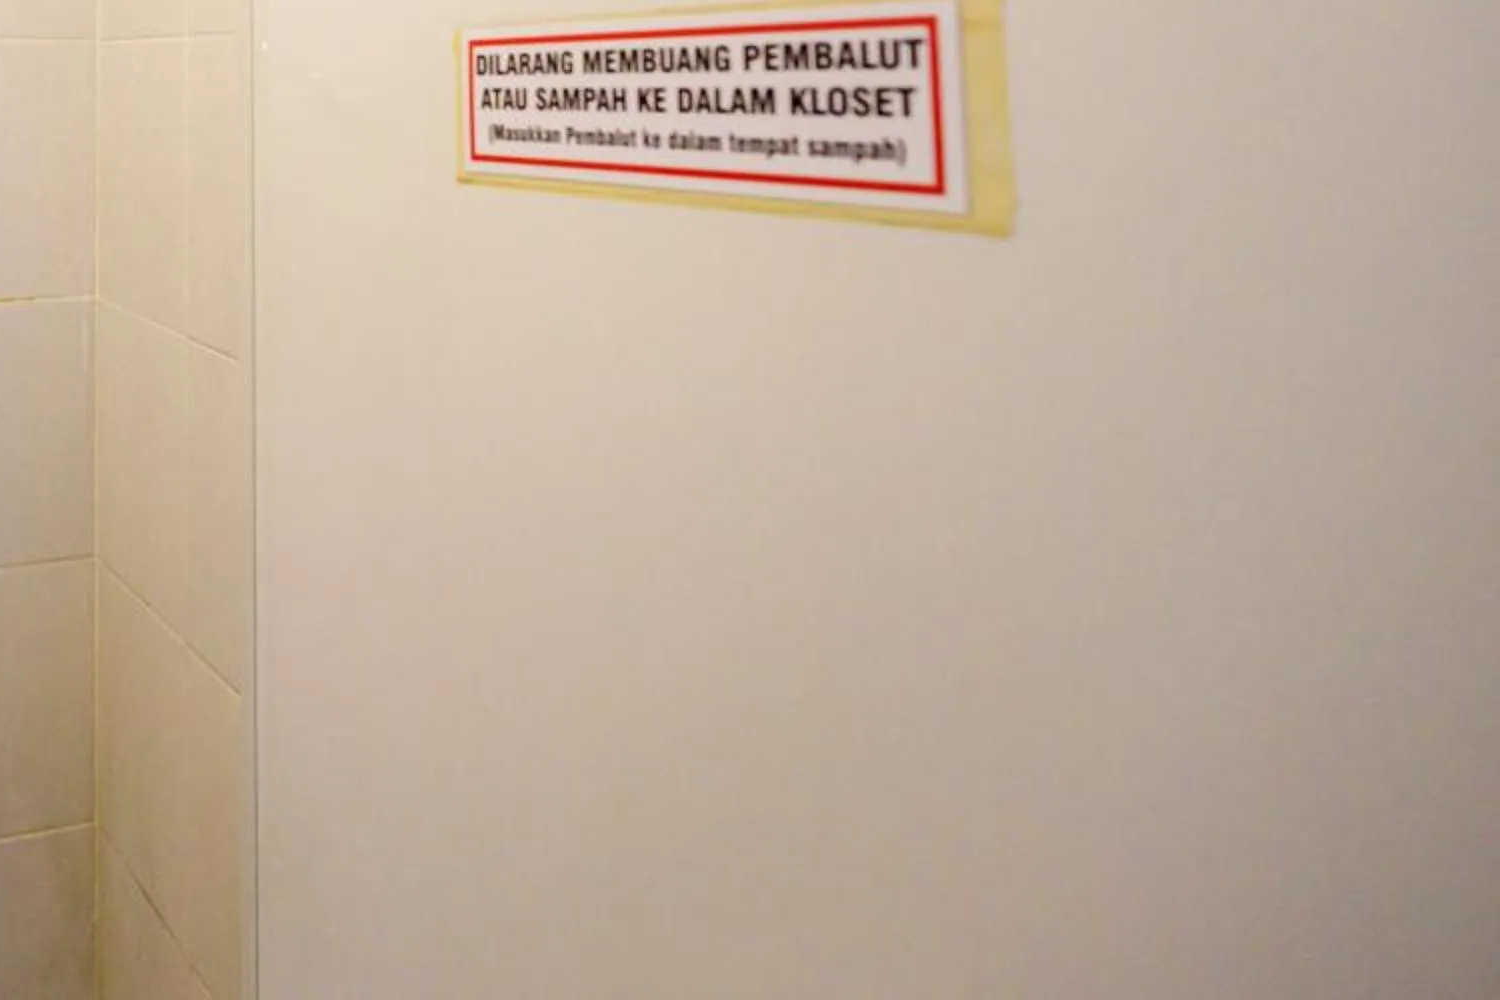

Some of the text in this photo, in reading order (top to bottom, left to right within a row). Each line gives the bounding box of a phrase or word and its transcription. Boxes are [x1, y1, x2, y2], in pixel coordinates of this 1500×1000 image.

[476, 39, 923, 76] DILARANG MEMBUANG PEMBALUT
[481, 87, 916, 117] ATAU SAMPAH KE DALAM KLOSET
[489, 123, 907, 166] (Masukkan Pembalut ke dalam tempat sampah)
